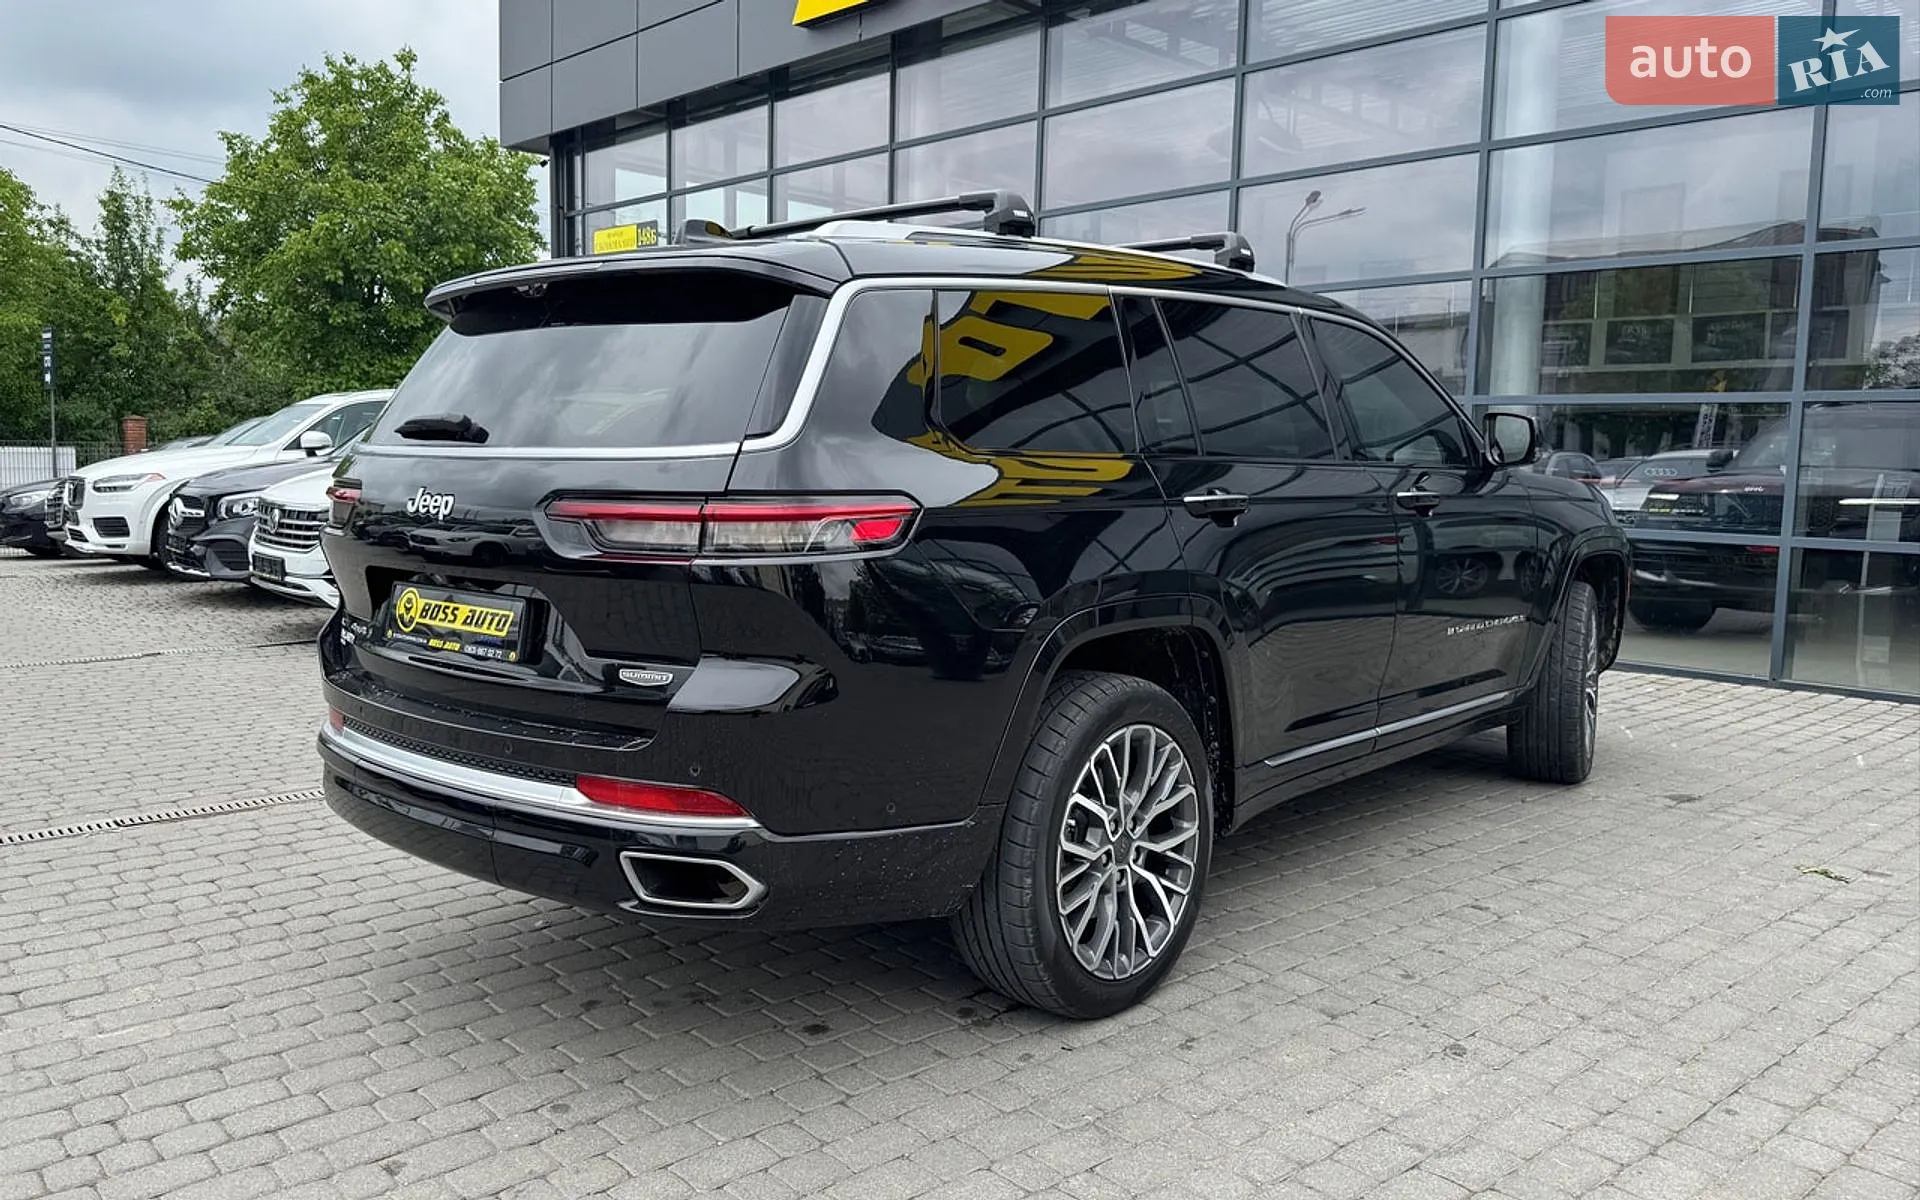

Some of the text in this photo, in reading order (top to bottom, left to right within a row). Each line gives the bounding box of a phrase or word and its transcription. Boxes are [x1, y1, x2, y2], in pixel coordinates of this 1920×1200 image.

[407, 487, 455, 521] Jeep
[420, 602, 511, 632] BOSS AUTO
[622, 671, 668, 681] SUMMIT
